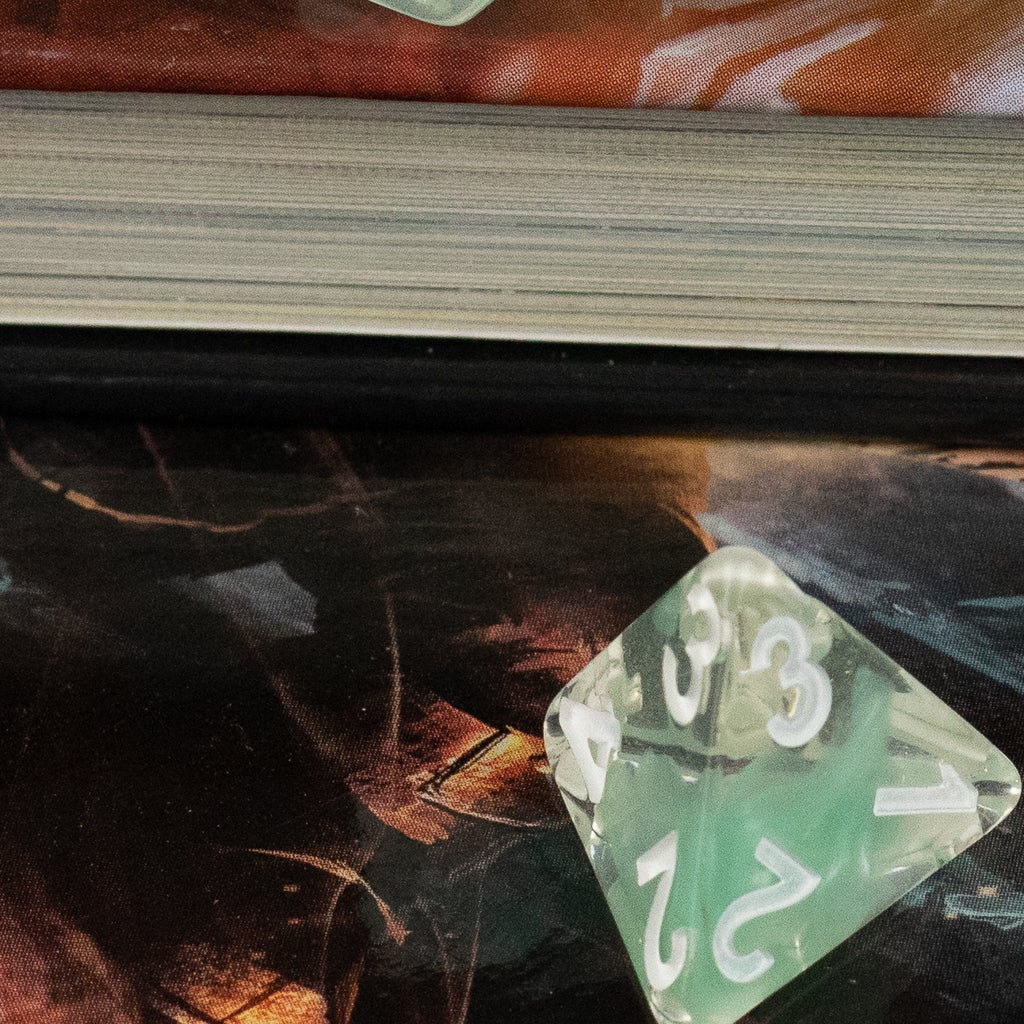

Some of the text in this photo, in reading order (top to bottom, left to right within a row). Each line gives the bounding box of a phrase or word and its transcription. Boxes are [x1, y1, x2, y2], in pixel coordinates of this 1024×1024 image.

[662, 583, 722, 727] 3
[749, 614, 833, 749] 3
[558, 695, 623, 805] 4
[872, 759, 980, 817] 1
[635, 828, 688, 993] 2
[712, 835, 822, 984] 2
